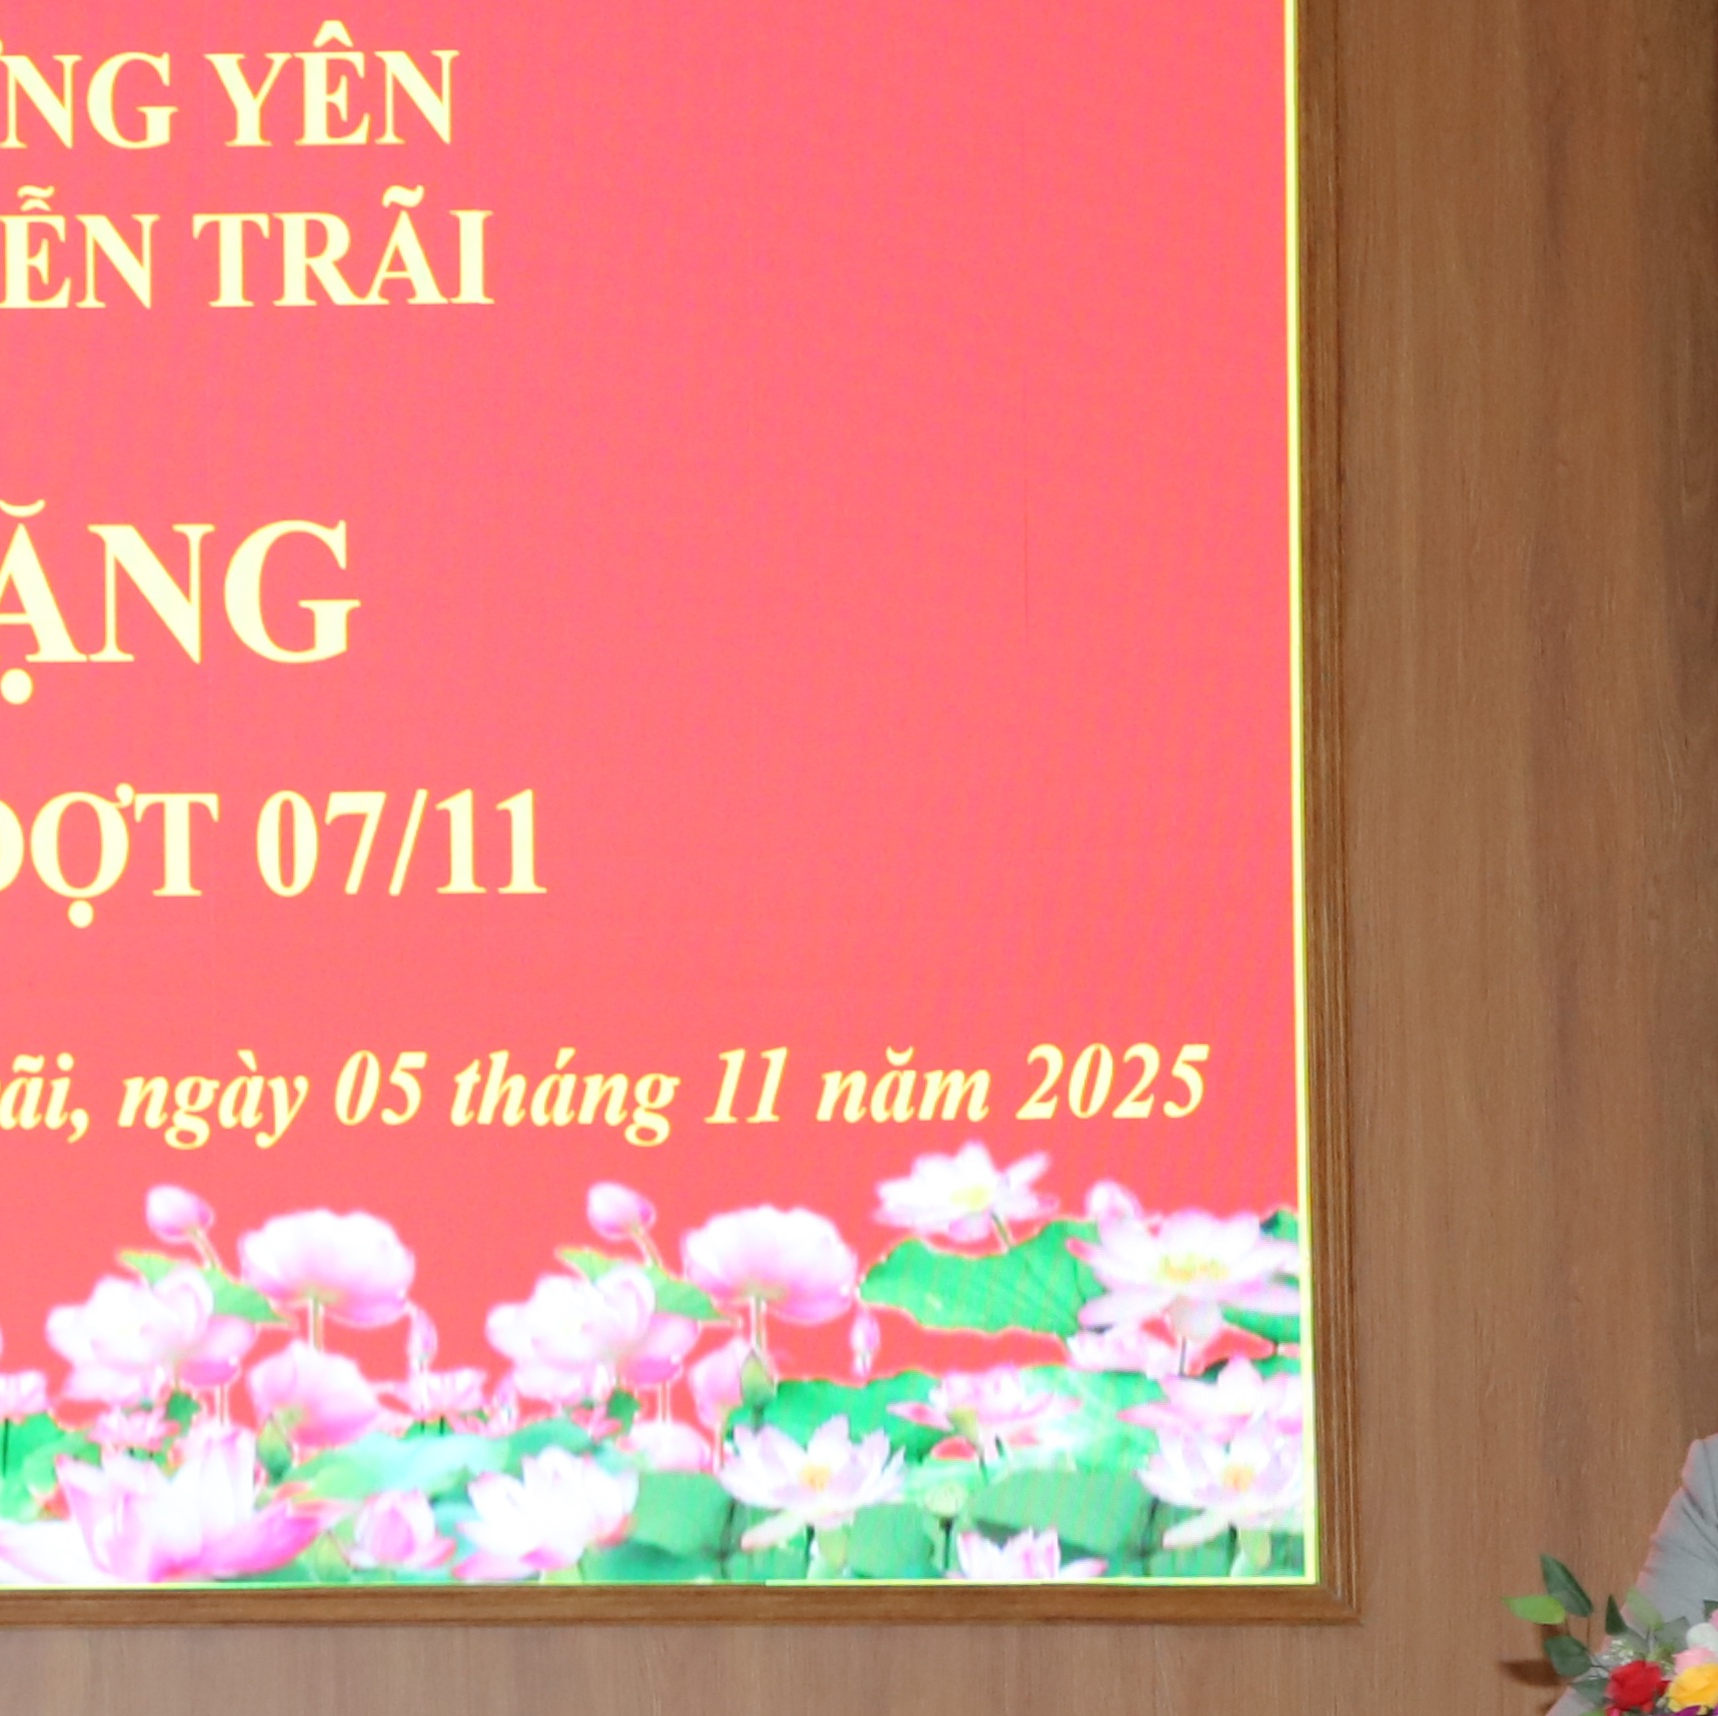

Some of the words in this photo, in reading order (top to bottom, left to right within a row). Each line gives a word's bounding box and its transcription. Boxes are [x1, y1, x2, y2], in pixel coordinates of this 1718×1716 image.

[205, 20, 459, 146] YÊN
[193, 185, 494, 307] TRÃI
[257, 789, 547, 897] 07/11
[118, 1050, 309, 1149] ngày
[335, 1050, 427, 1125] 05
[451, 1047, 680, 1146] tháng
[705, 1047, 788, 1123] 11
[817, 1047, 990, 1122] năm
[1016, 1043, 1209, 1120] 2025
